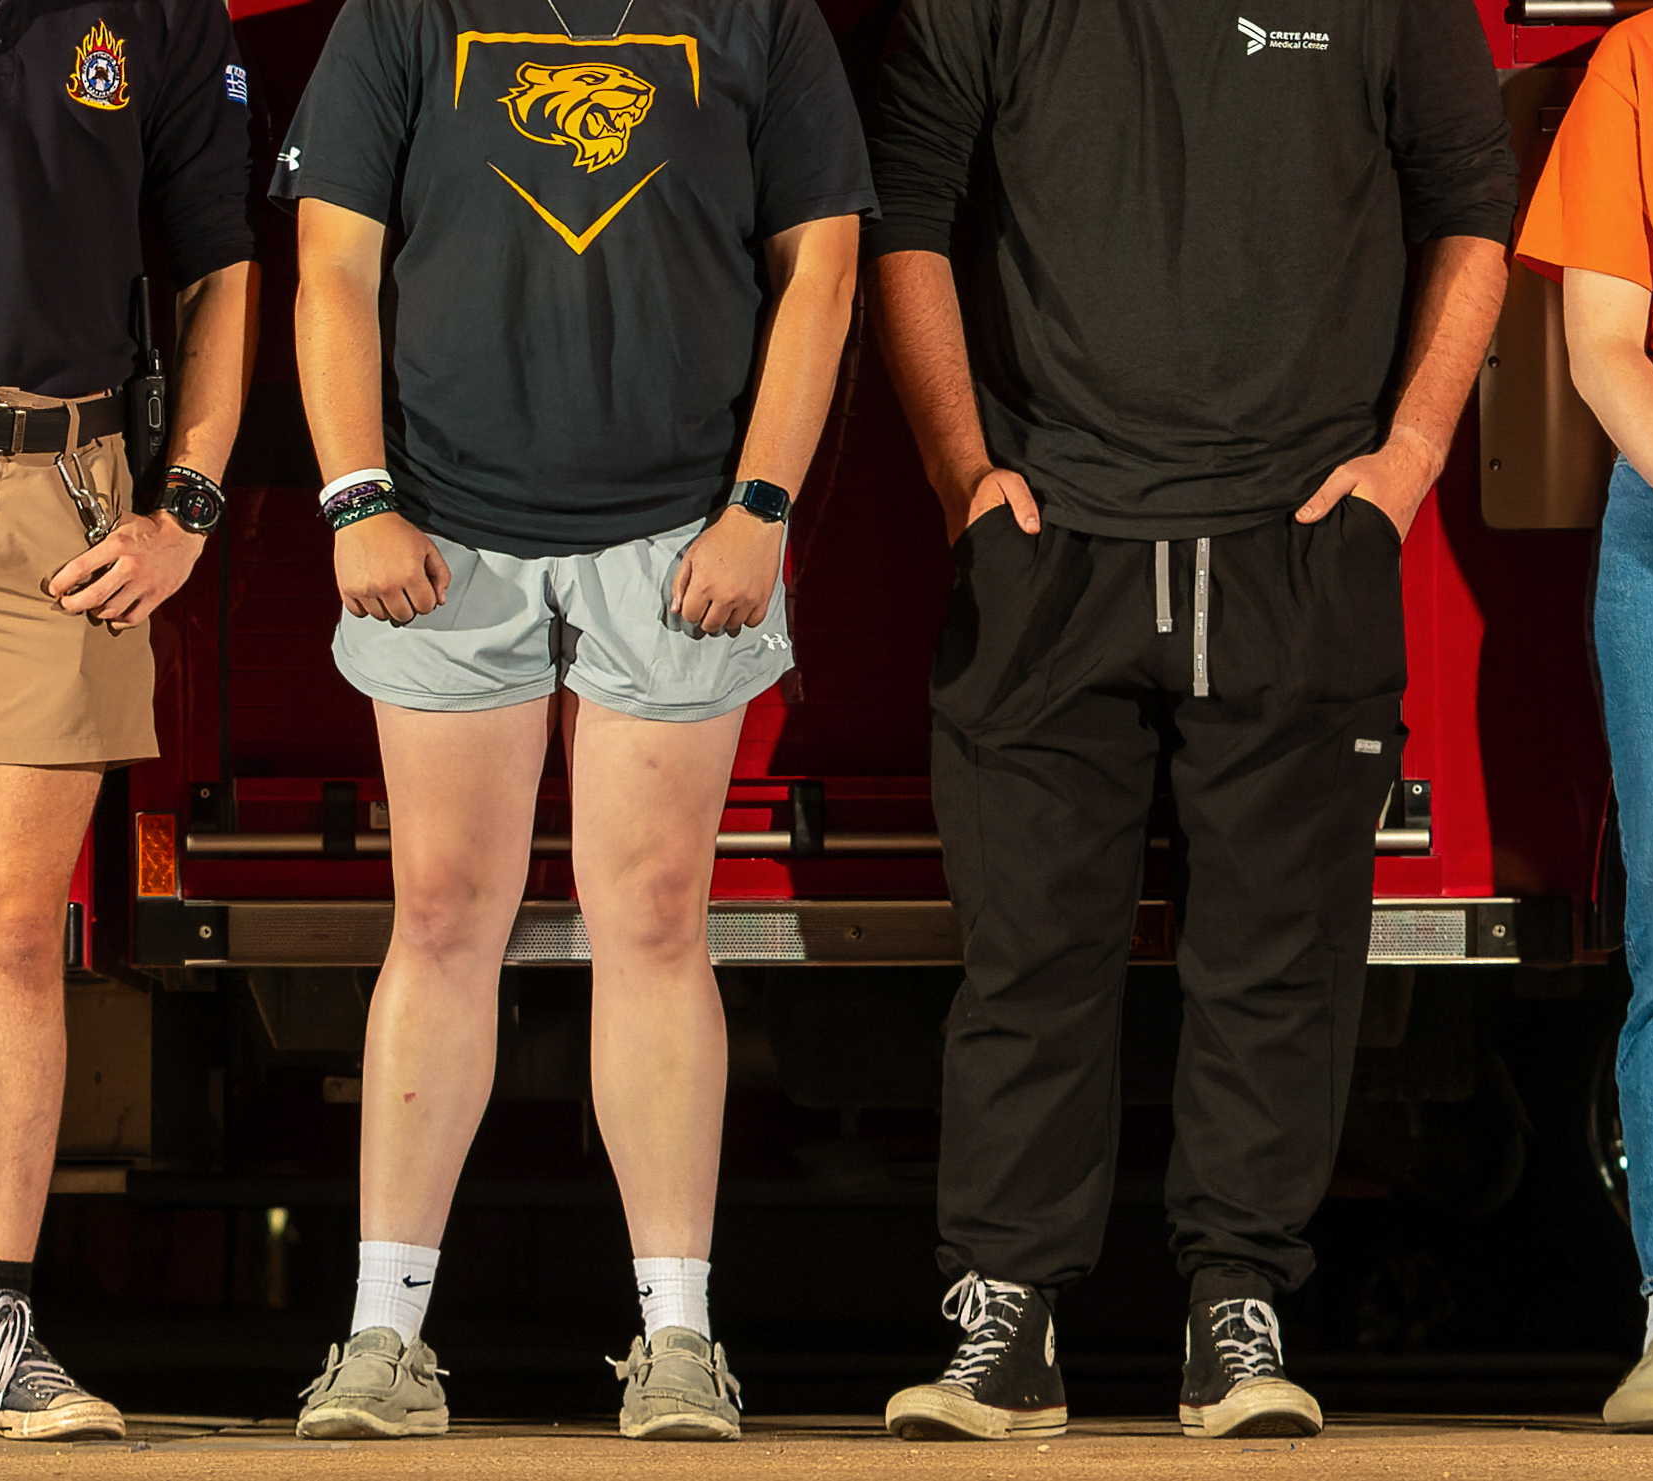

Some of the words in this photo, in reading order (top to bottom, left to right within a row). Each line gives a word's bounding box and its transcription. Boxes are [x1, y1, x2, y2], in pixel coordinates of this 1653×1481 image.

[1269, 31, 1301, 40] CRETE
[1302, 32, 1330, 41] AREA
[1269, 40, 1301, 49] Medical
[1302, 41, 1329, 50] Center
